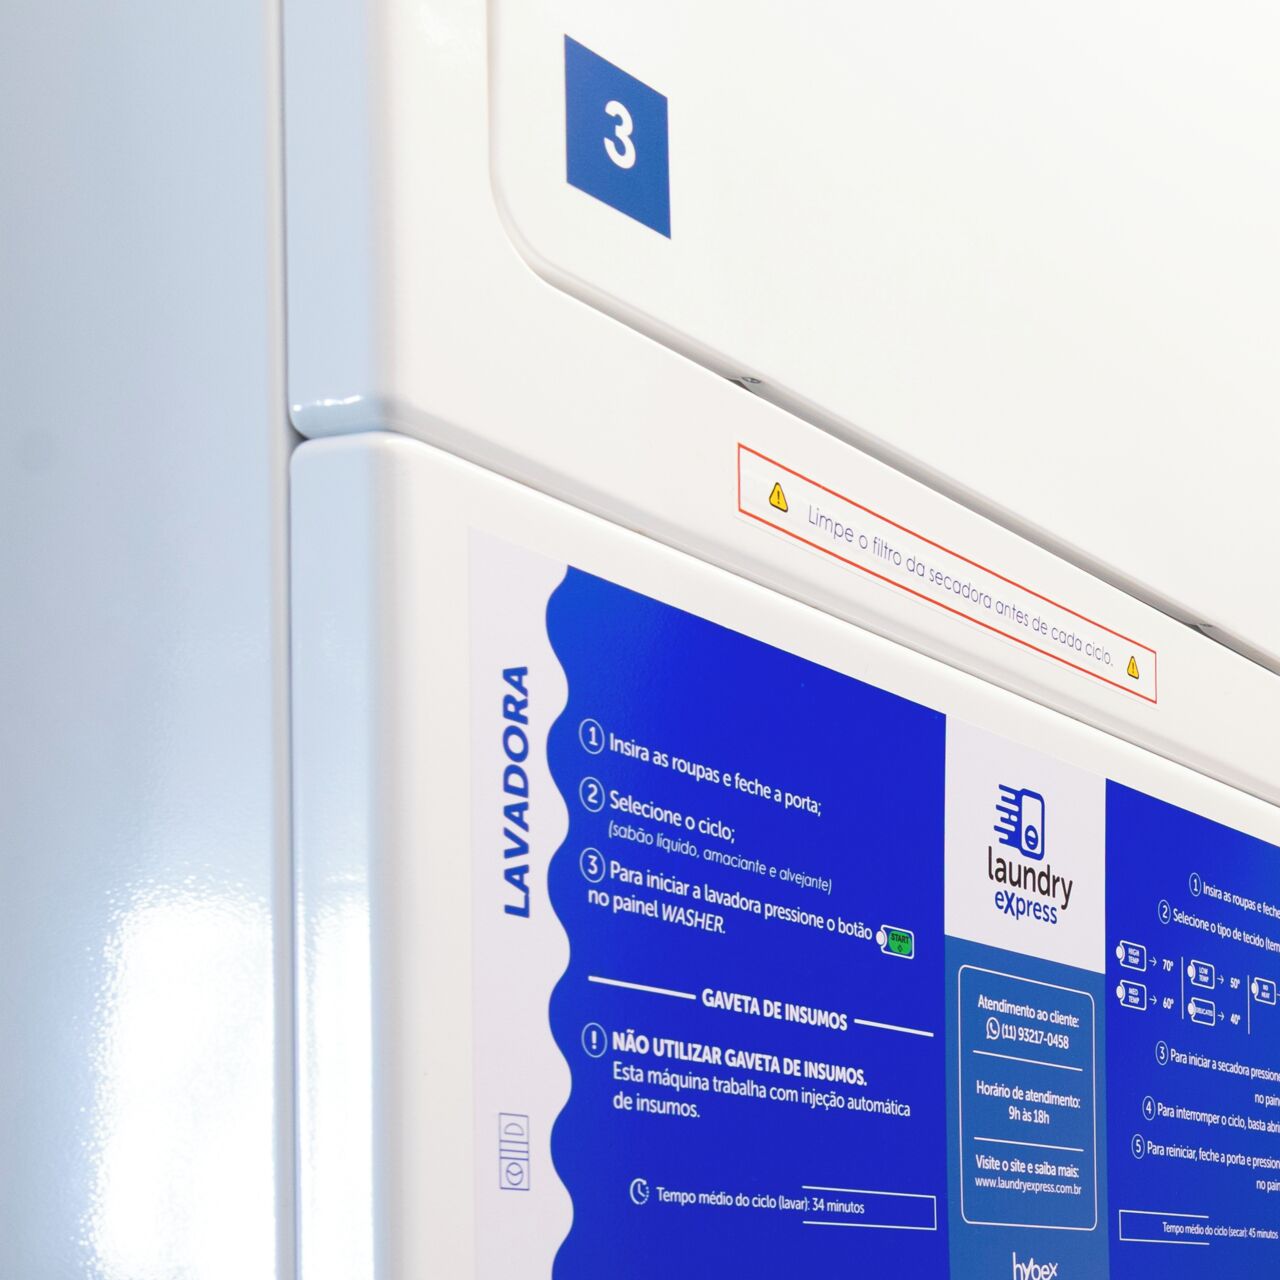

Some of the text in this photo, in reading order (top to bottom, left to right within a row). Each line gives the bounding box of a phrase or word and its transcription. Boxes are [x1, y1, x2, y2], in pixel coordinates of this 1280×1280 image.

[603, 100, 636, 169] 3
[808, 504, 1114, 667] Limpe o filtro da secadora antes de cada ciclo.
[503, 666, 530, 919] LAVADORA
[609, 732, 650, 762] Insira
[652, 750, 669, 768] as
[672, 756, 720, 784] roupas
[723, 774, 731, 786] e
[734, 772, 772, 800] feche
[774, 789, 781, 802] a
[784, 792, 822, 817] porta;
[609, 789, 682, 827] Selecione
[685, 816, 695, 830] o
[698, 817, 735, 844] ciclo;
[608, 819, 832, 896] (sabão líquido, amaciante e alvejante)
[987, 846, 1073, 910] laundry
[588, 889, 726, 934] no painel WASHER.
[610, 860, 643, 886] Para
[646, 869, 690, 897] iniciar
[693, 886, 700, 899] a
[704, 883, 762, 914] lavadora
[764, 903, 825, 929] pressione
[827, 919, 835, 931] o
[837, 916, 873, 941] botão
[701, 988, 848, 1031] GAVETA DE INSUMOS
[977, 994, 1080, 1028] Atendimento ao cliente:
[612, 1028, 868, 1087] NÃO UTILIZAR GAVETA DE INSUMOS.
[1002, 1024, 1070, 1050] (11) 93217-0458
[612, 1090, 701, 1118] de insumos.
[613, 1060, 911, 1117] Esta máquina trabalha com injeção automática
[976, 1079, 1081, 1109] Horário de atendimento:
[1009, 1106, 1050, 1125] 9h às 18h
[974, 1176, 1082, 1195] www.laundryexpress.com.br
[975, 1154, 1080, 1178] Visite o site e saiba mais:
[655, 1186, 865, 1214] Tempo médio do ciclo (lavar): 34 minutos
